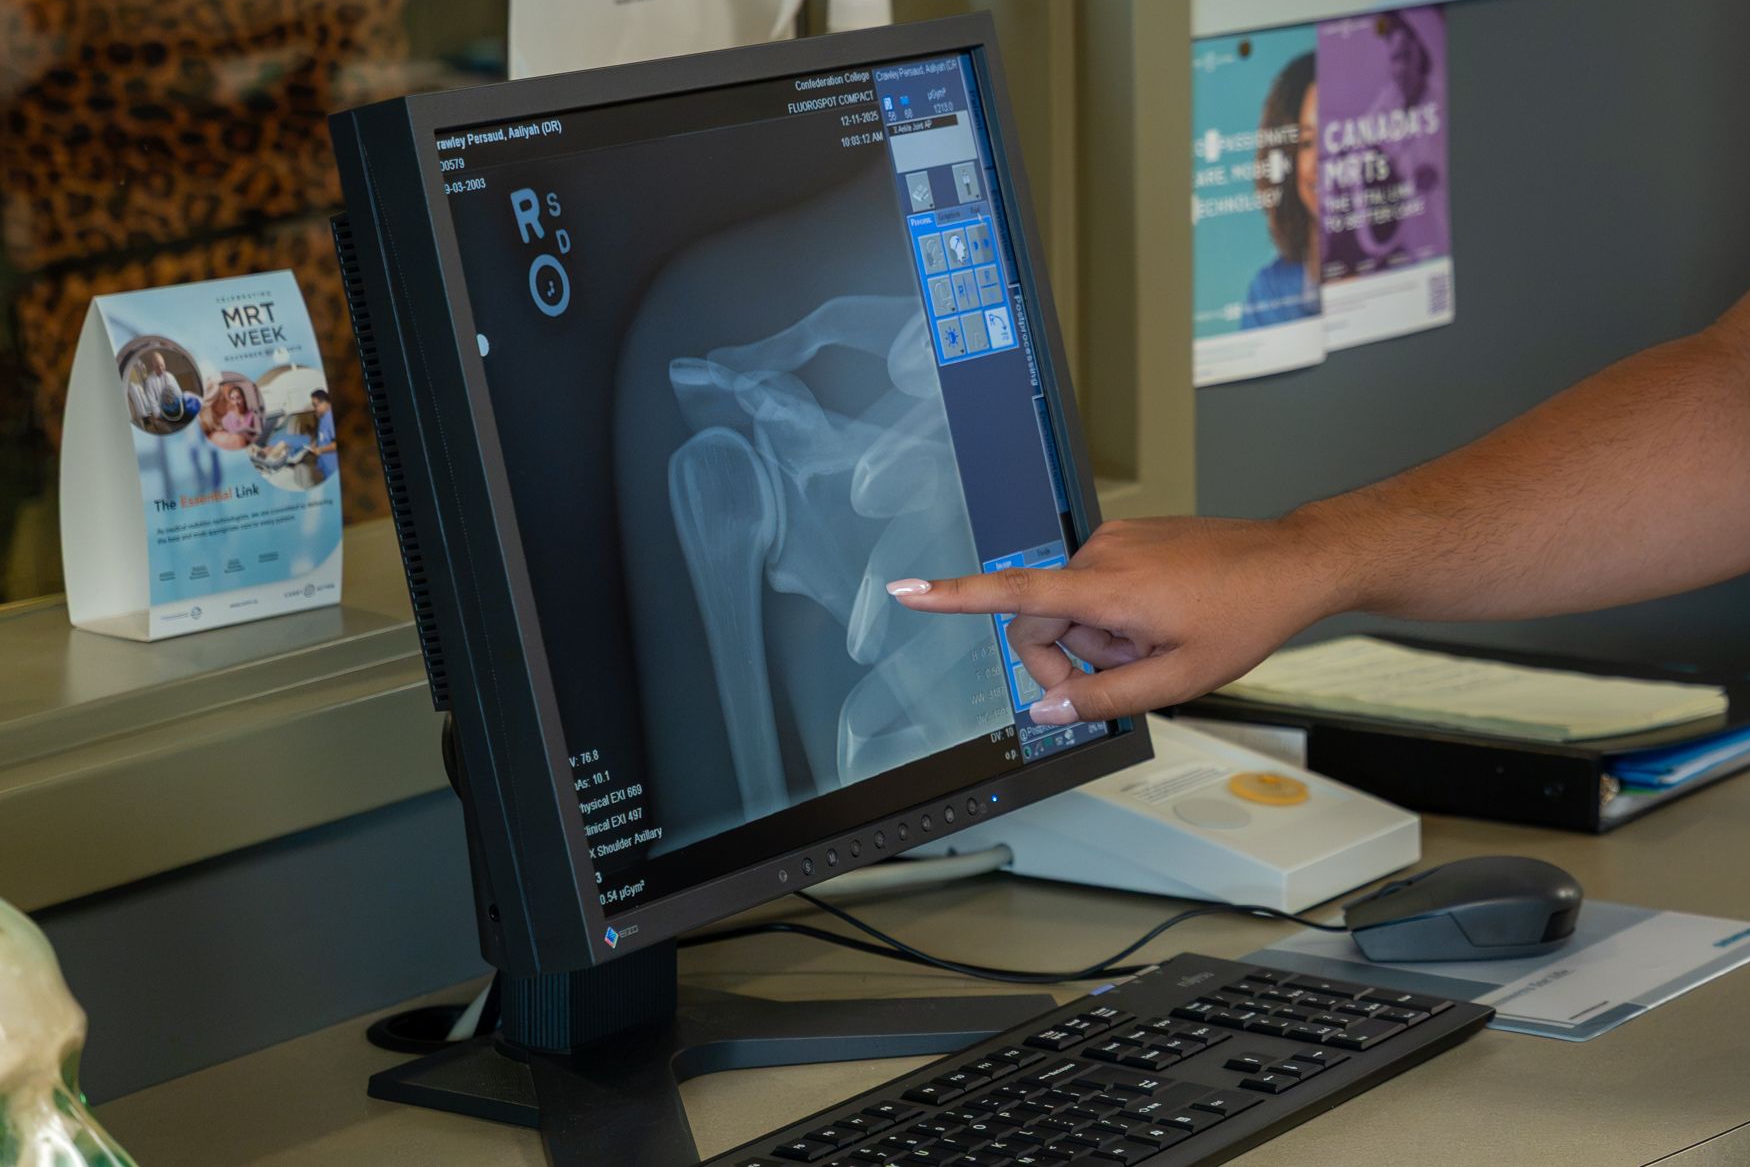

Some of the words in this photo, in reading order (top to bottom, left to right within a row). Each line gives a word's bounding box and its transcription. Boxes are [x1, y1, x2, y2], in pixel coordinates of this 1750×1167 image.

[795, 76, 844, 91] Confederation
[844, 71, 871, 84] College
[788, 96, 838, 115] FLUOROSPOT
[839, 89, 875, 106] COMPACT
[467, 130, 508, 146] Persaud,
[508, 123, 540, 140] Aaliyah
[541, 120, 562, 136] (DR)
[872, 131, 884, 143] AM
[510, 187, 545, 244] R
[546, 192, 561, 217] S
[555, 228, 571, 254] D
[221, 301, 275, 330] MRT
[227, 324, 287, 349] WEEK
[1014, 295, 1039, 386] Postprocessing
[154, 500, 177, 512] The
[180, 487, 232, 509] Essential
[235, 484, 260, 499] Link
[1005, 727, 1014, 737] 10
[580, 749, 599, 764] 76.8
[592, 770, 610, 786] 10.1
[579, 794, 610, 814] hysical
[610, 788, 626, 804] EXI
[627, 784, 643, 798] 669
[584, 819, 611, 837] linical
[611, 813, 627, 828] EXI
[628, 807, 643, 822] 497
[597, 835, 633, 857] Shoulder
[634, 826, 663, 845] Axillary
